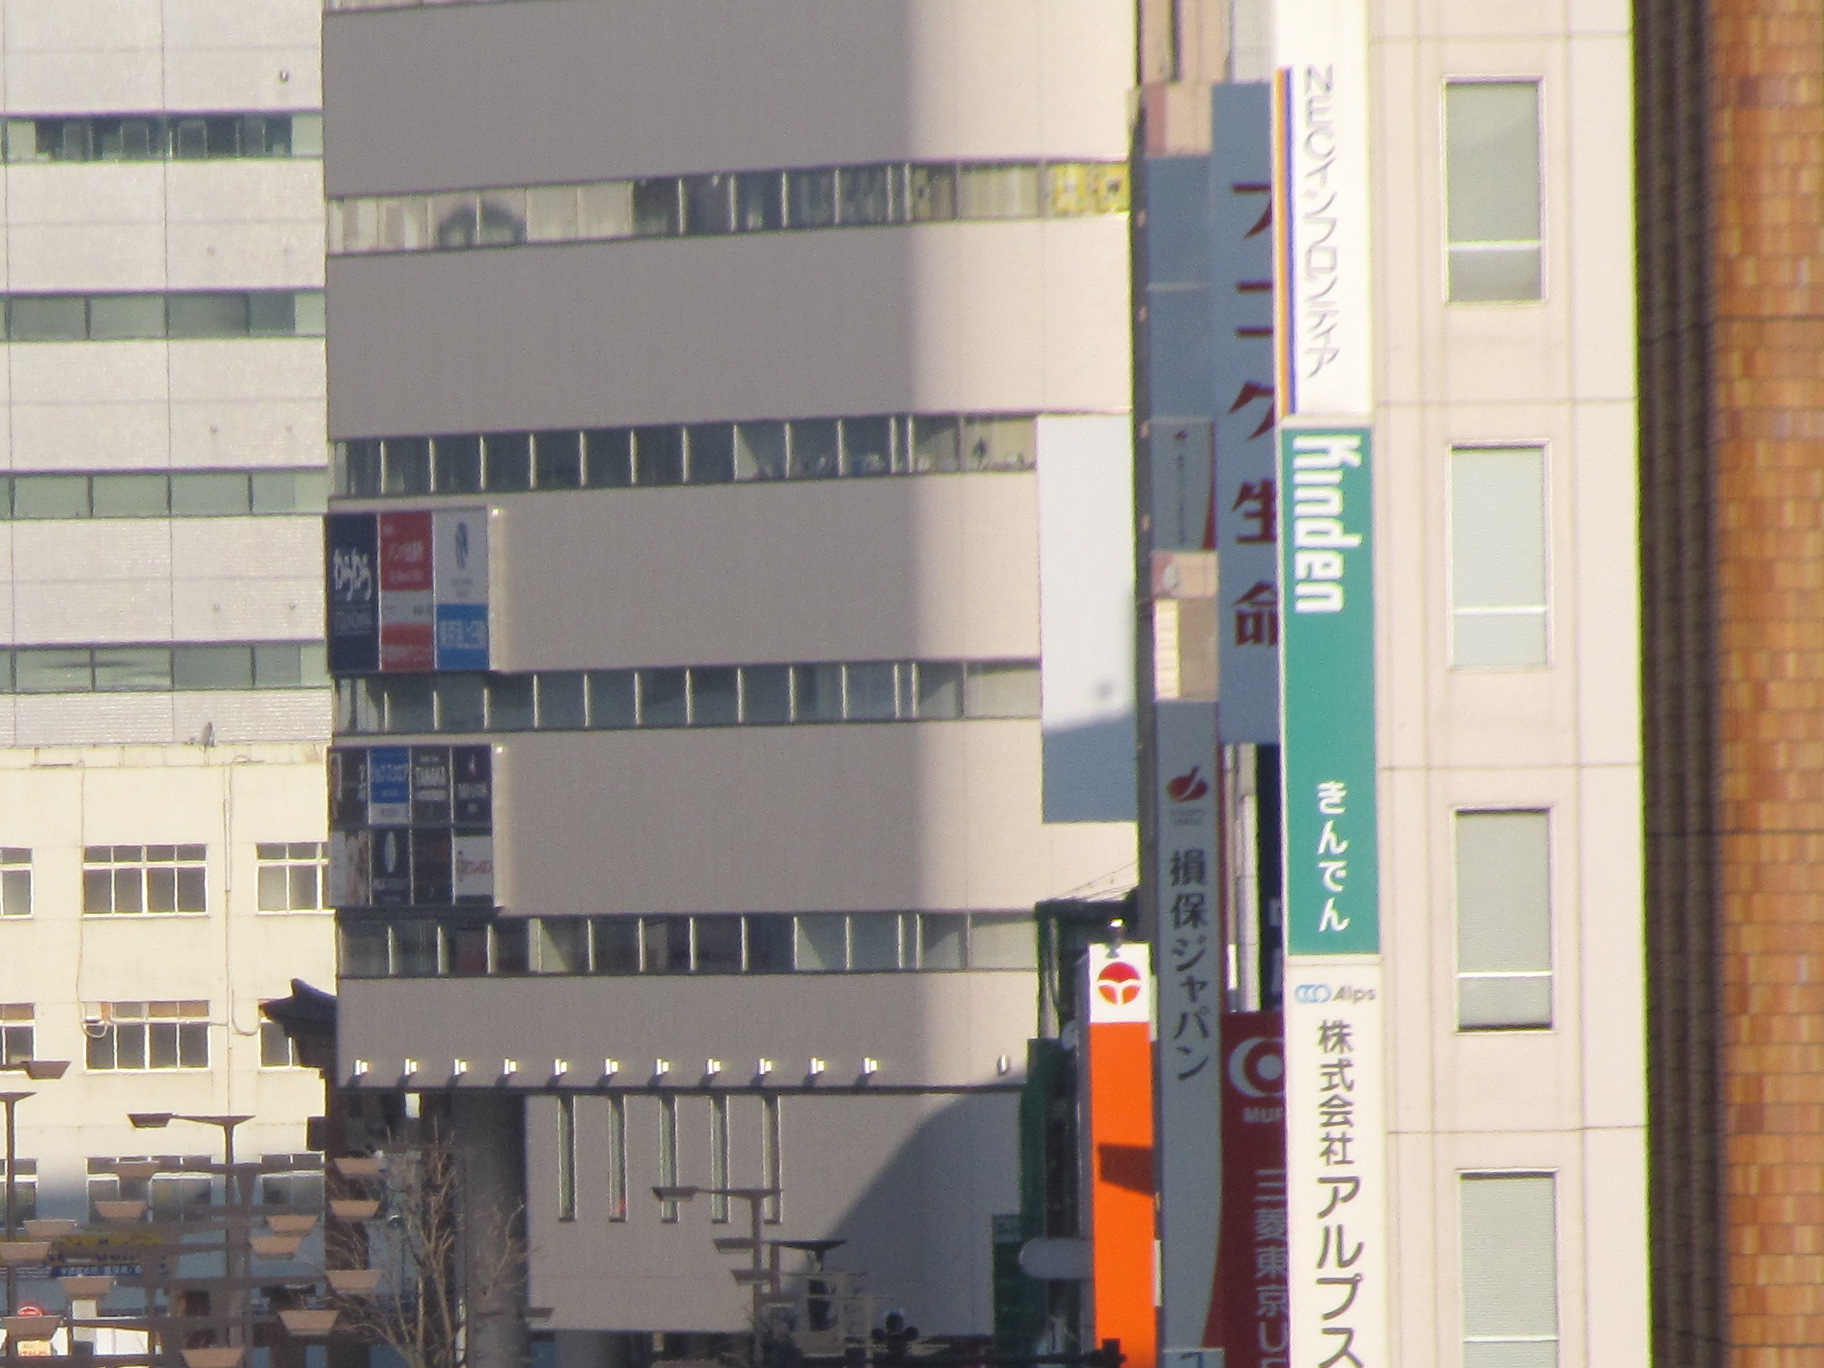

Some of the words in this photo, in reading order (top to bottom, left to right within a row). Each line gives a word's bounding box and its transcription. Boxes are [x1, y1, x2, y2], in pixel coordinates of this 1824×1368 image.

[1293, 433, 1362, 613] Kinden
[1317, 780, 1351, 932] きんでん
[1170, 848, 1210, 1083] 損保ジャパン
[1332, 984, 1376, 1004] Alps
